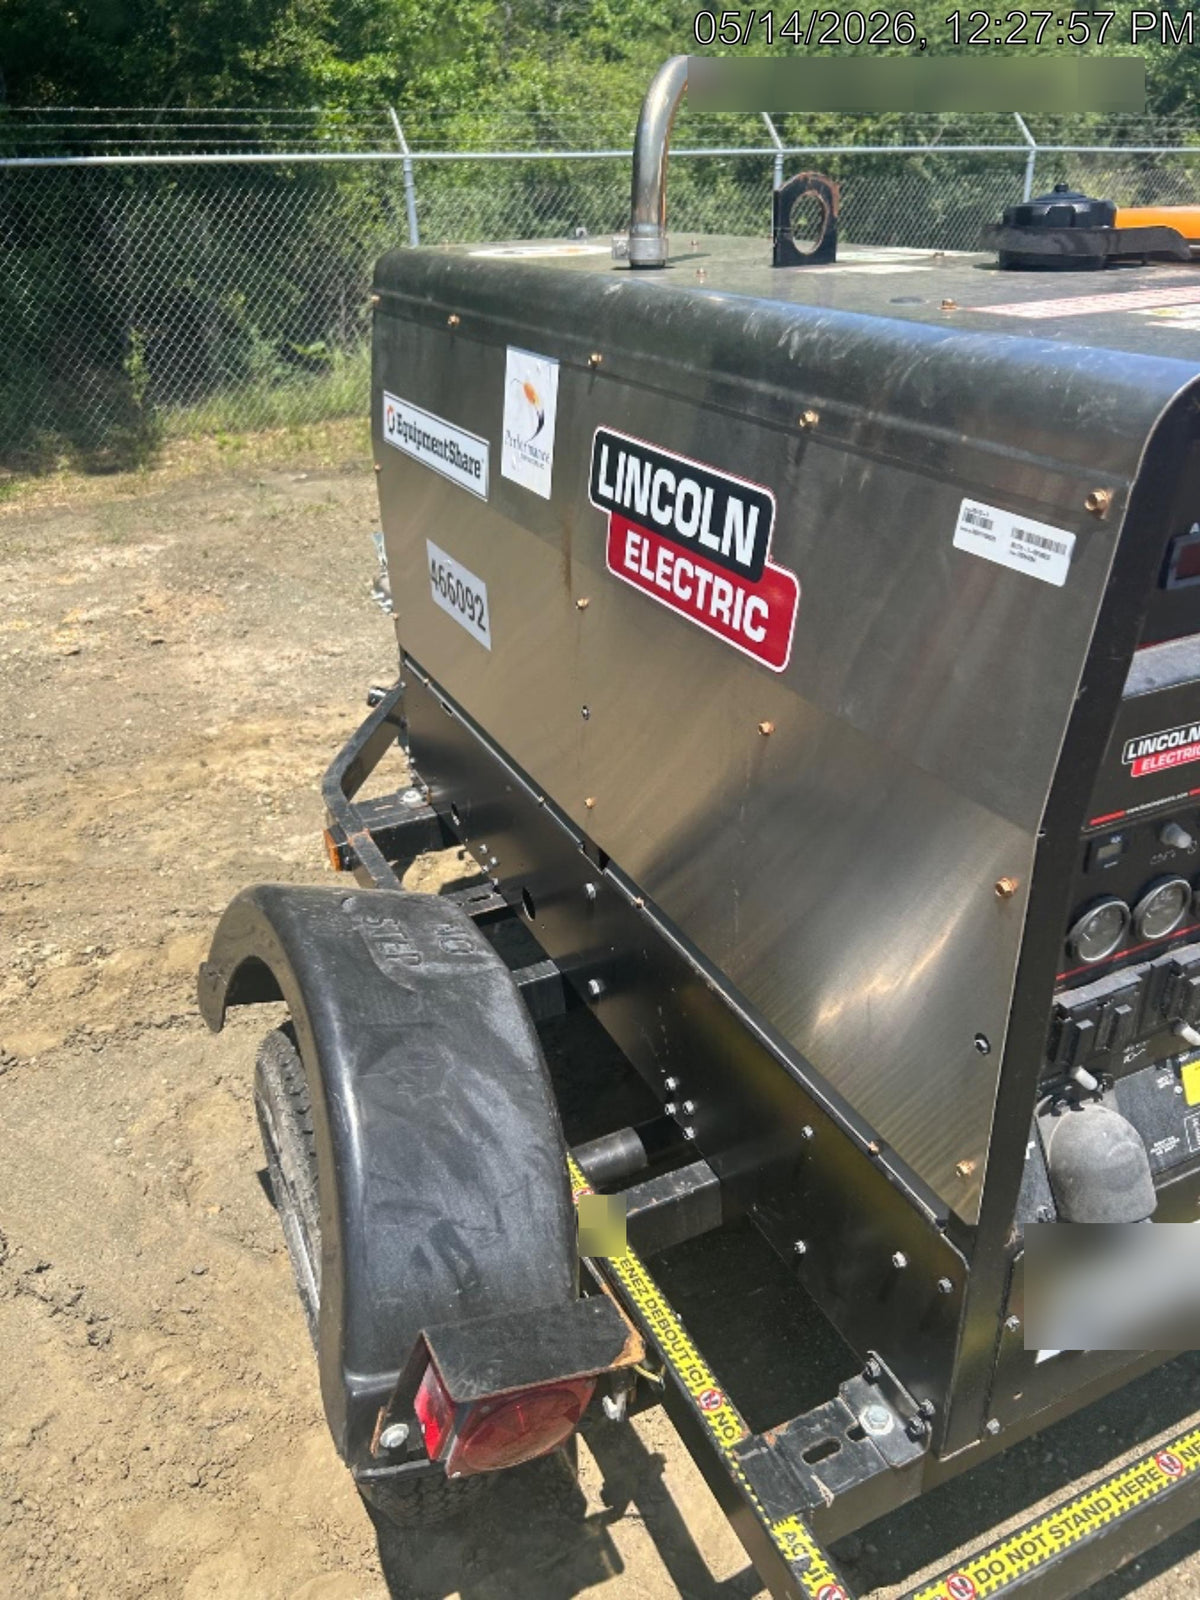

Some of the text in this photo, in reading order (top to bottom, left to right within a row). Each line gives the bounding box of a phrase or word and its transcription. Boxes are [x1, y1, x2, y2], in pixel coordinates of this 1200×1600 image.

[396, 412, 481, 479] EquipmentShare
[597, 444, 759, 567] LINCOLN
[431, 558, 487, 632] 466092
[623, 529, 769, 643] ELECTRIC
[1127, 726, 1200, 760] LINCOLN
[619, 1257, 707, 1389] ENEZ DEBOUT ICI
[714, 1411, 737, 1440] NO
[973, 1466, 1161, 1586] DO NOT STAND HERE
